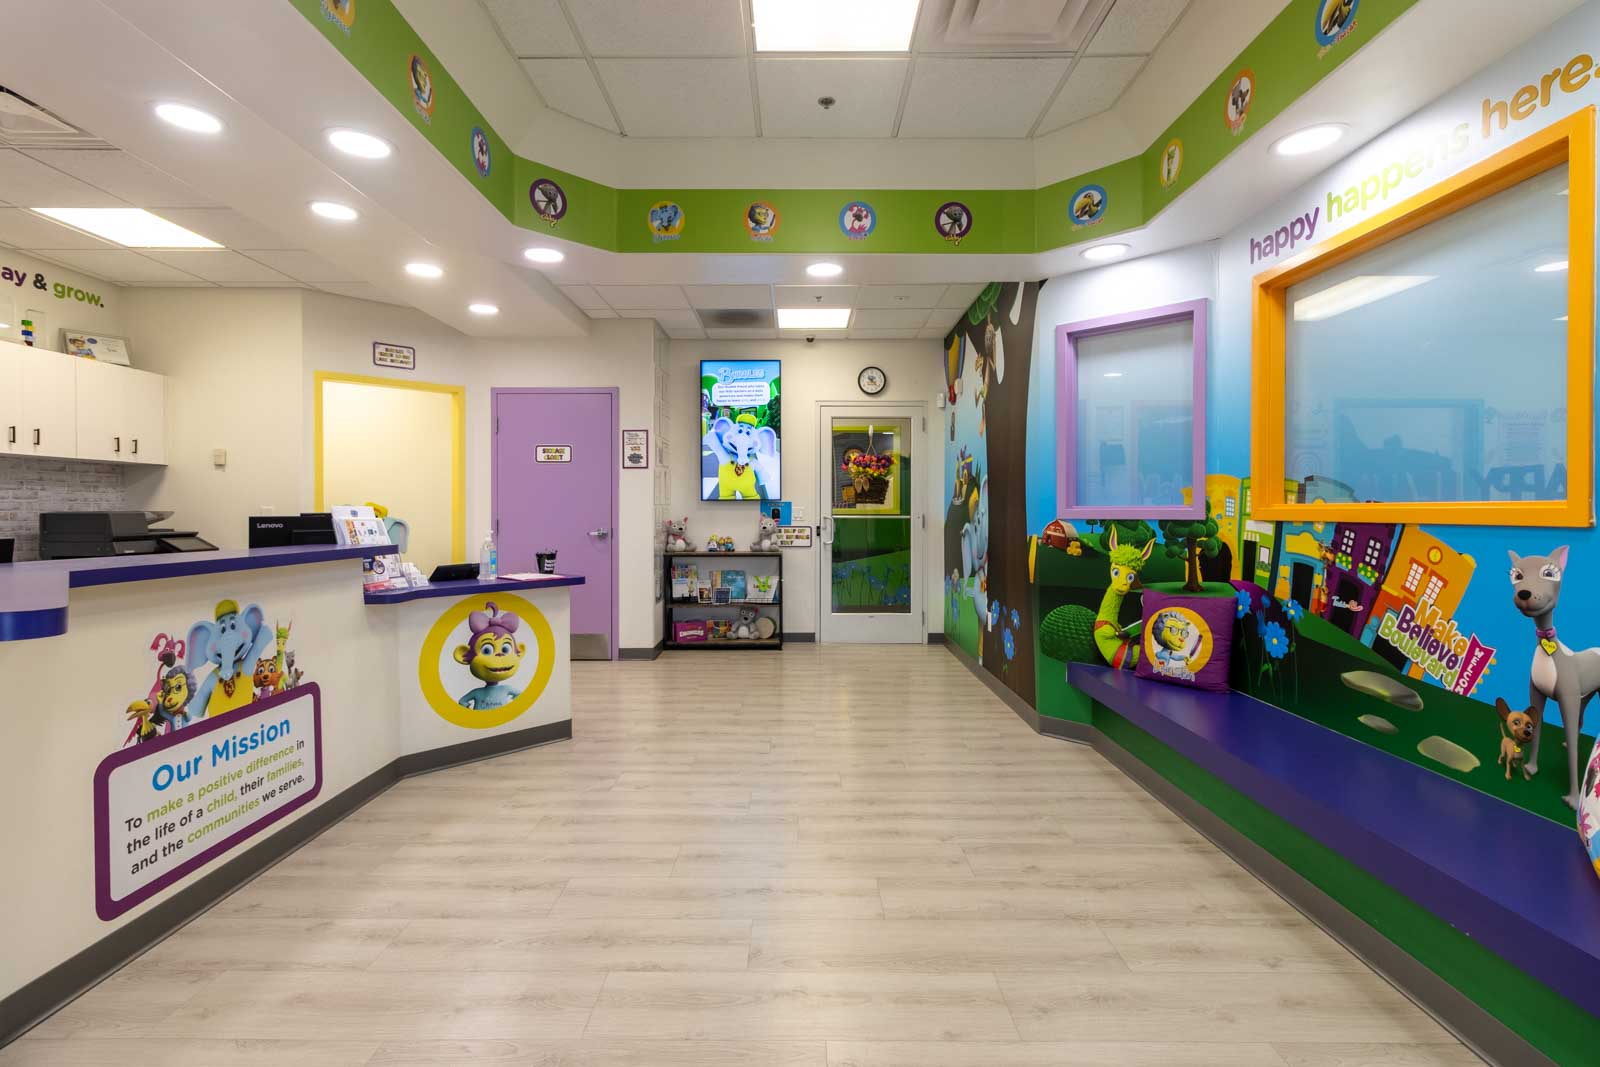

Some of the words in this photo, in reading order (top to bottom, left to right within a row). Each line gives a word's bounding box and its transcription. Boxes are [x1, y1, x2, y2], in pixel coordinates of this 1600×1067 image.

[1249, 206, 1320, 264] happy
[1326, 121, 1472, 223] happens
[33, 273, 47, 291] &
[53, 282, 104, 308] grow.
[1379, 614, 1460, 686] Boulevard
[1397, 605, 1460, 671] Believe
[1414, 598, 1468, 657] Make
[125, 817, 142, 833] To
[146, 796, 183, 823] make
[187, 792, 195, 803] a
[198, 769, 244, 800] positive
[246, 744, 295, 775] difference
[296, 739, 305, 750] in
[152, 755, 203, 791] Our
[211, 719, 291, 767] Mission
[126, 835, 151, 854] the
[154, 821, 176, 841] life
[179, 810, 193, 827] of
[196, 807, 204, 818] a
[207, 790, 238, 813] child,
[240, 775, 265, 796] their
[266, 758, 305, 782] families,
[130, 853, 158, 875] and
[162, 838, 184, 859] the
[187, 798, 260, 844] communities
[261, 789, 277, 803] we
[278, 775, 305, 795] serve.
